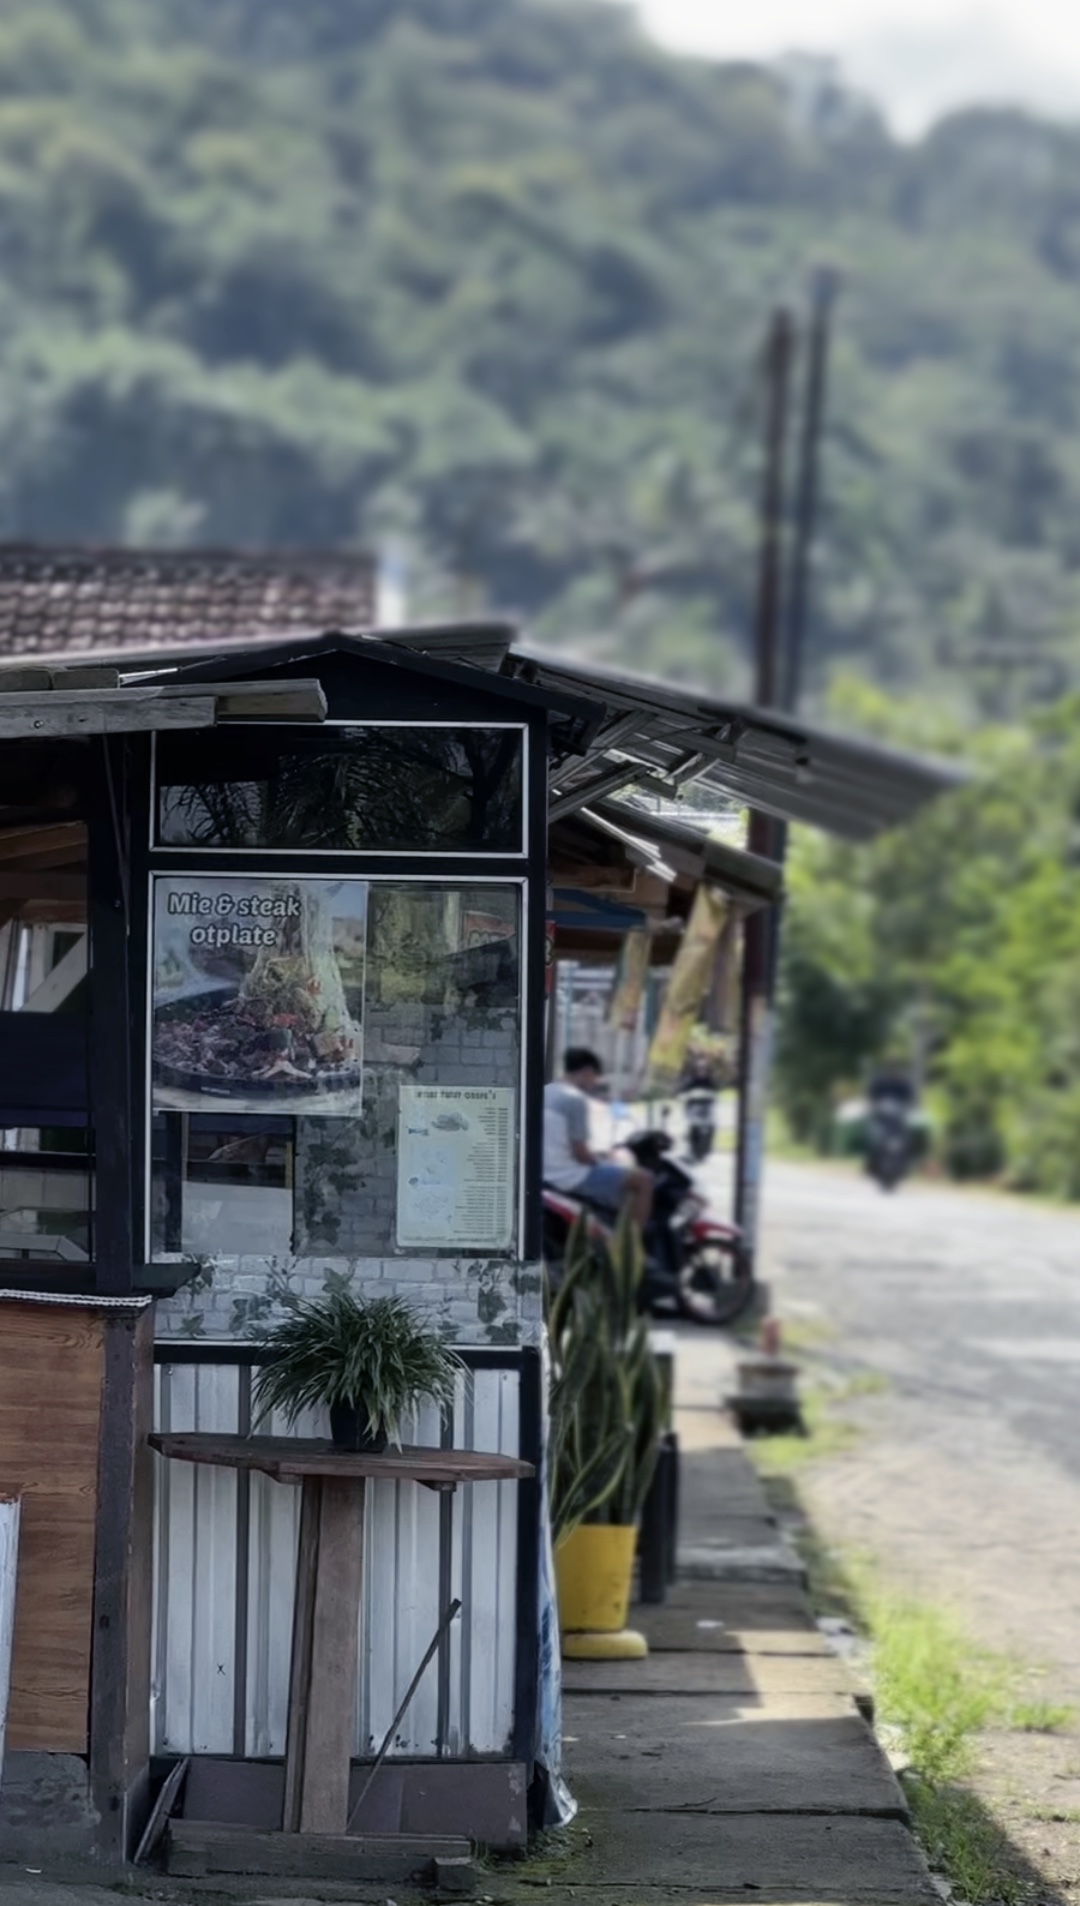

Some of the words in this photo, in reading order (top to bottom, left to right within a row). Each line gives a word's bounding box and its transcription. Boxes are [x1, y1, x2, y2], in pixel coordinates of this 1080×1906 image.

[168, 893, 211, 914] Mie
[215, 894, 234, 915] &
[238, 896, 300, 916] steak
[191, 925, 276, 947] otplate
